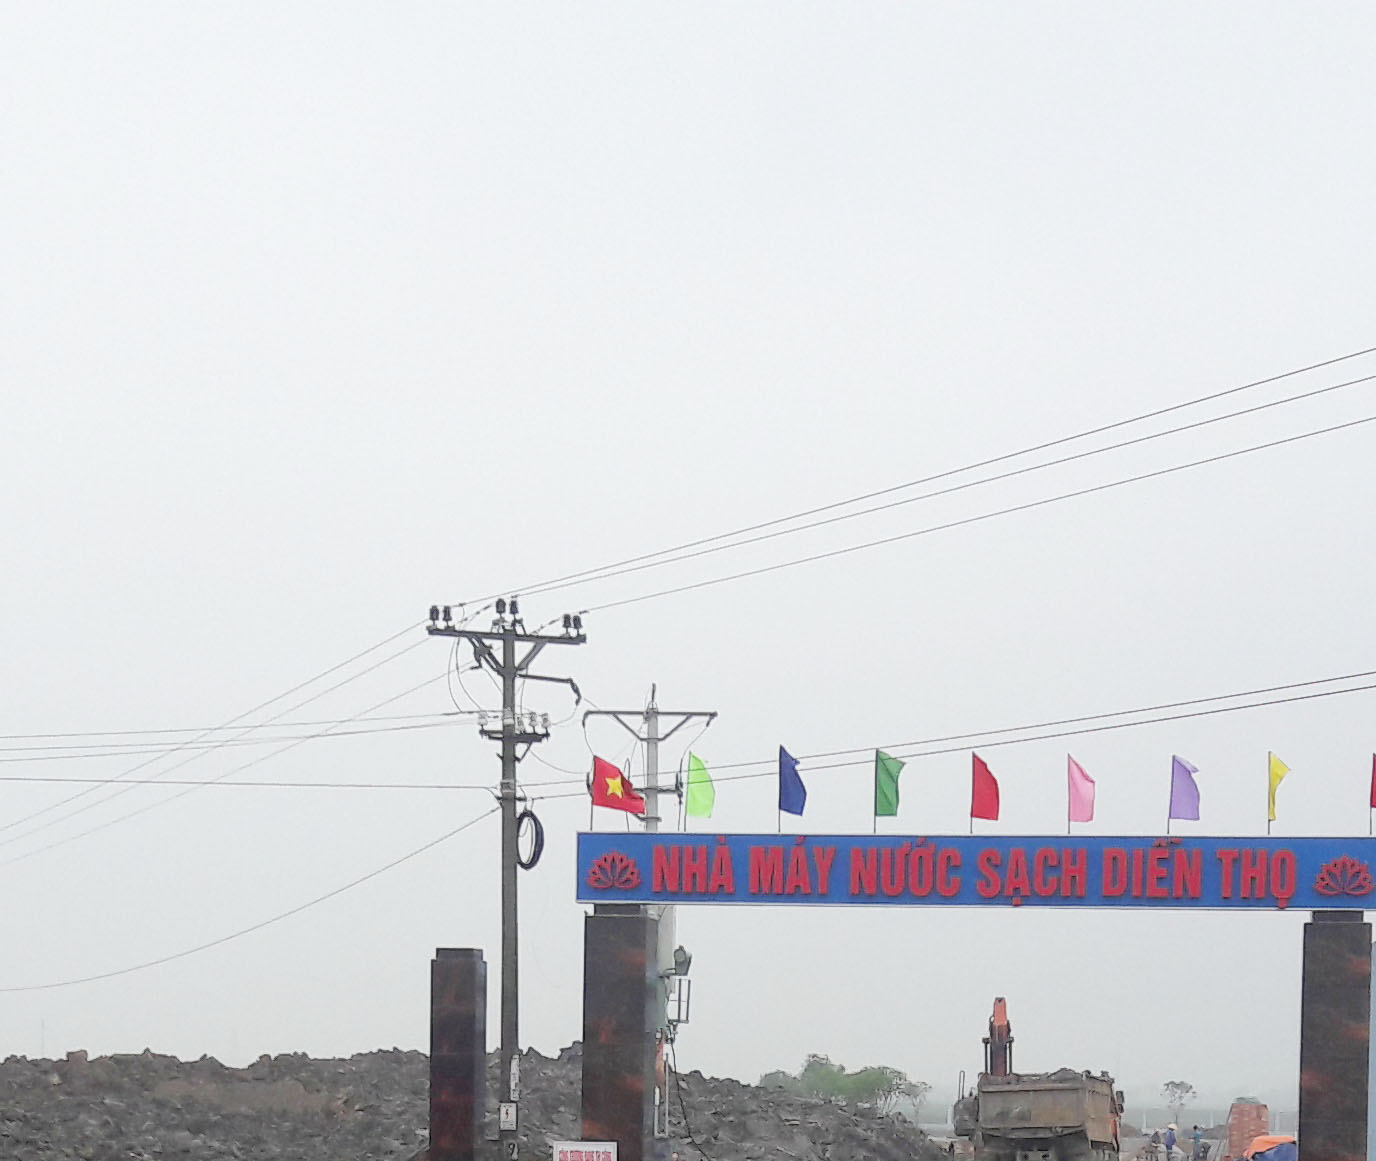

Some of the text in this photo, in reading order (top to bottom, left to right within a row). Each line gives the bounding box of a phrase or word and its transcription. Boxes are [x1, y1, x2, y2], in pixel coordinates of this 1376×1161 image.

[651, 835, 1297, 908] NHÀ MÁY NƯỚC SẠCH DIỄN THỌ
